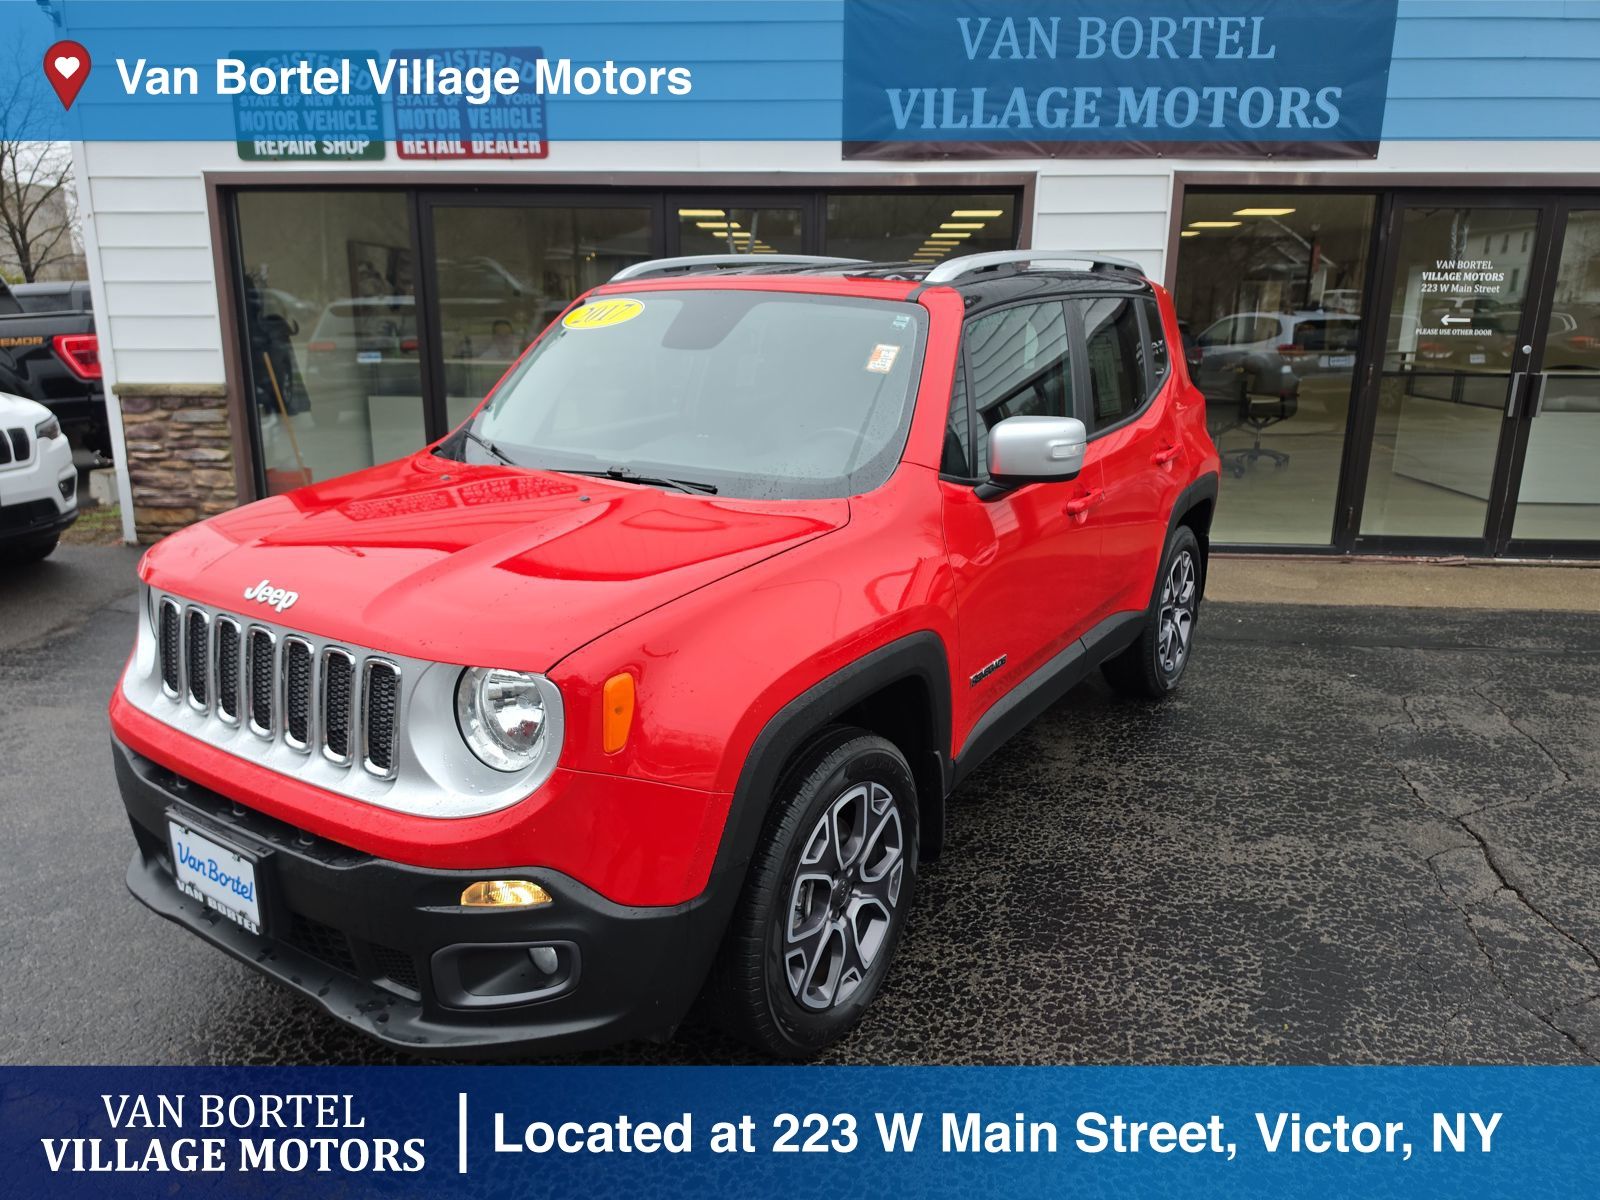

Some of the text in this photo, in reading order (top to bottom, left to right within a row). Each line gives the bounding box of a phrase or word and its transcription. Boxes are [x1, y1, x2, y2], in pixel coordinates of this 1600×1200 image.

[957, 17, 1276, 59] VAN BORTEL
[239, 94, 375, 107] STATE OF NEW YORK
[396, 94, 439, 106] STATE
[443, 94, 463, 106] OF
[503, 93, 541, 105] YORK
[886, 87, 1343, 129] VILLAGE MOTORS
[239, 109, 379, 132] MOTOR VEHICLE
[397, 106, 542, 130] MOTOR VEHICLE
[253, 133, 371, 155] REPAIR SHOP
[401, 132, 542, 154] RETAIL DEALER
[1436, 260, 1493, 270] VAN BORTEL
[1422, 271, 1505, 281] VILLAGE MOTORS
[1420, 283, 1500, 294] 223 W Main Street
[1415, 328, 1438, 336] PLEASE
[1439, 328, 1451, 336] USE
[243, 579, 299, 613] Jeep
